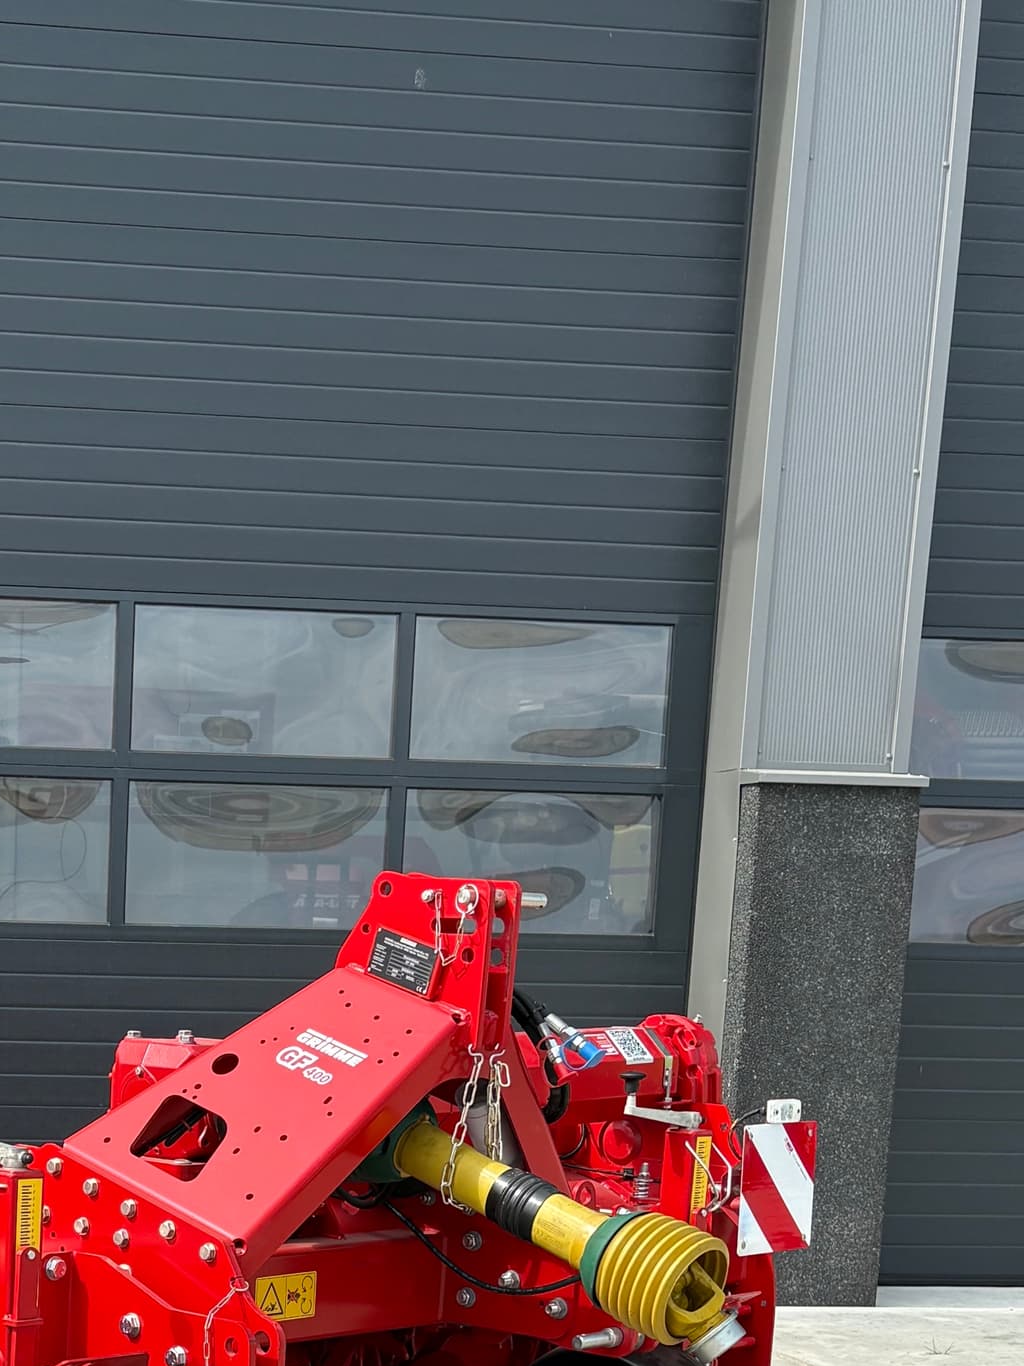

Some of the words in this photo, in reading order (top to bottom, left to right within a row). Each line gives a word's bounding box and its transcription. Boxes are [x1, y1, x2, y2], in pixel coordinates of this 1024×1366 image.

[277, 1046, 318, 1070] GF
[303, 1067, 332, 1084] 400
[296, 1028, 368, 1067] GRIMME
